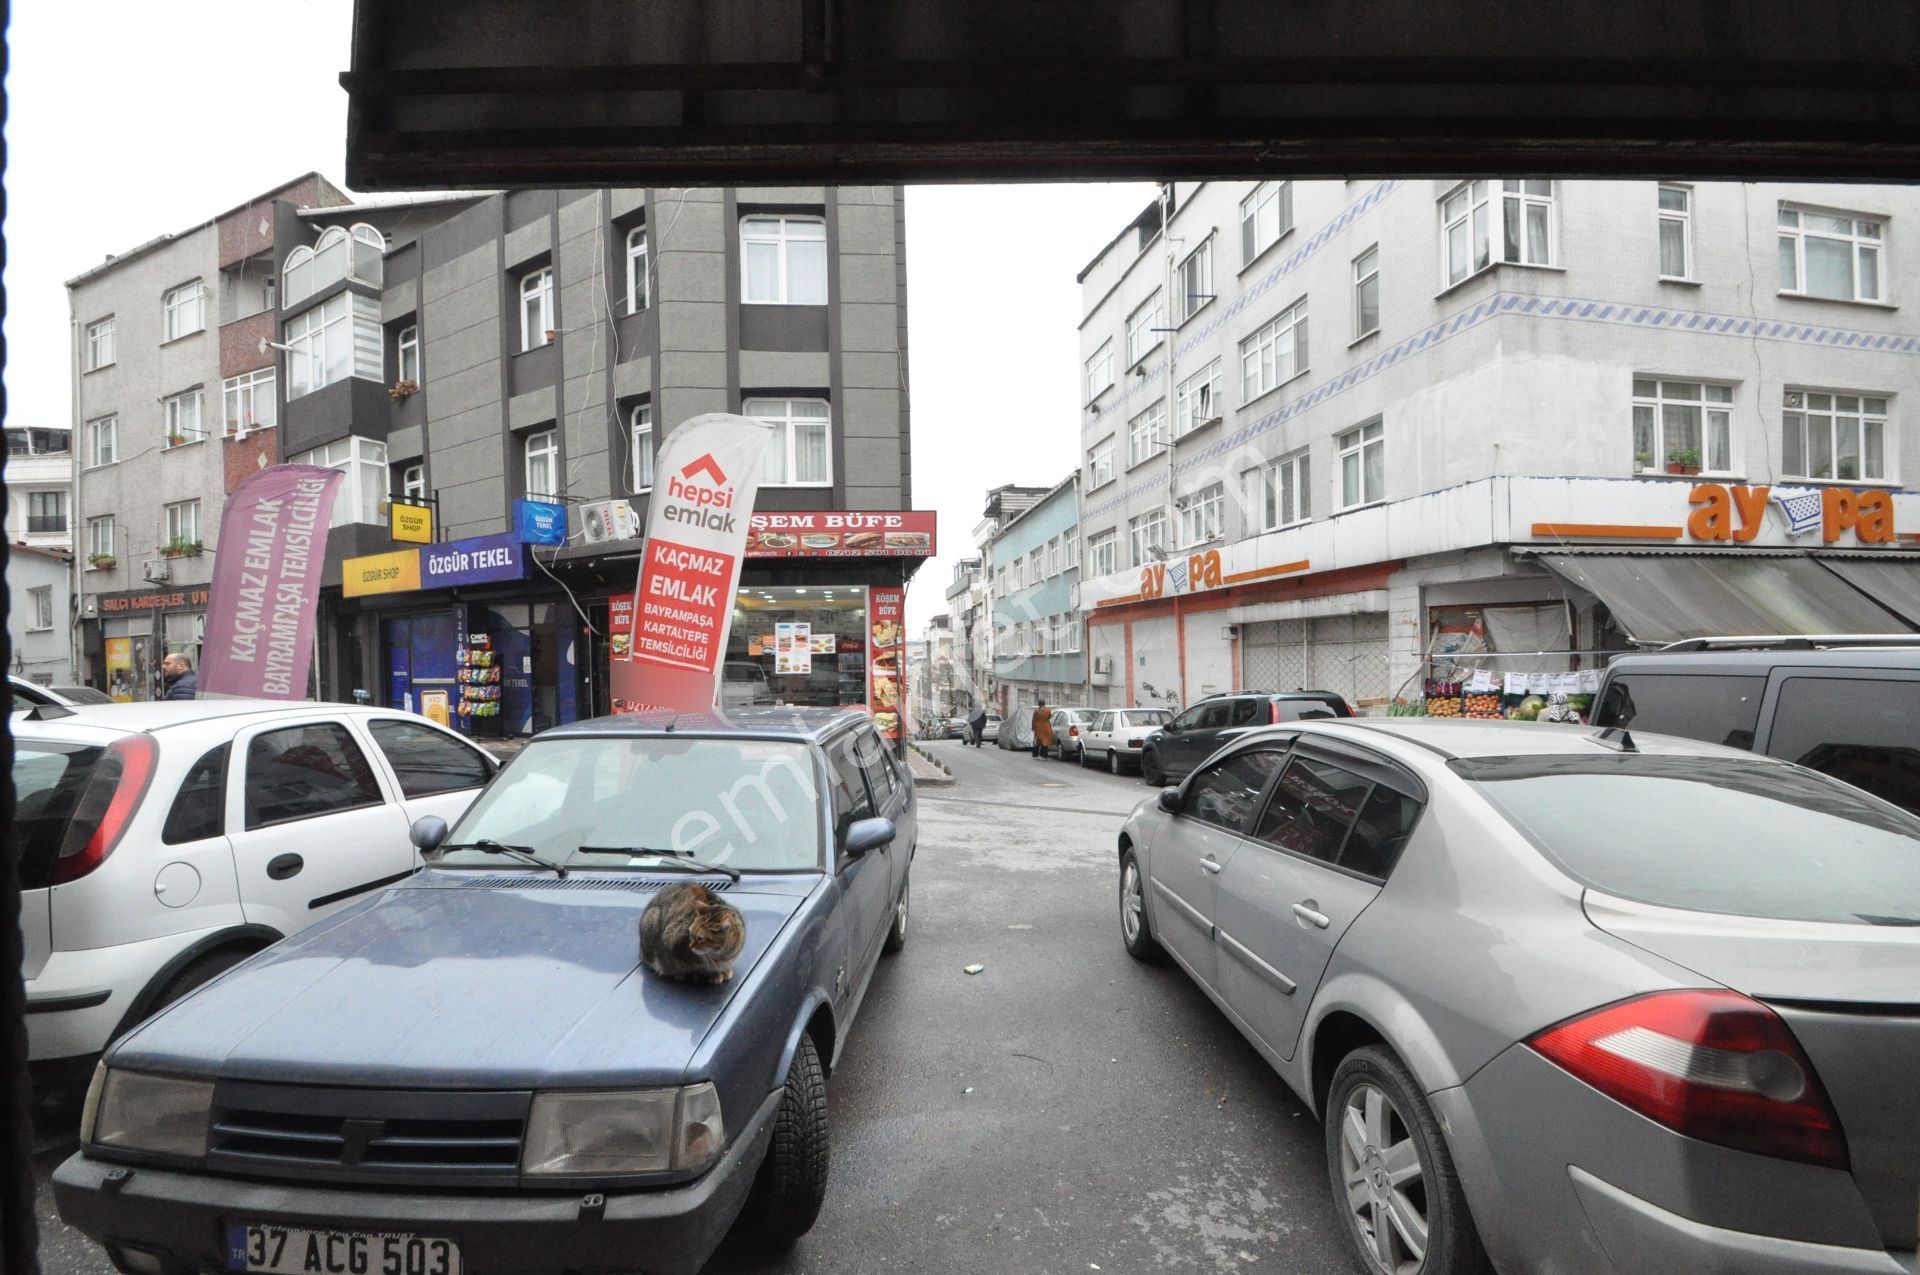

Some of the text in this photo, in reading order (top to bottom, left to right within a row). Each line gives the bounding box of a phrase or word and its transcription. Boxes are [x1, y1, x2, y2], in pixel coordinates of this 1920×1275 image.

[668, 476, 734, 510] hepsi
[400, 514, 423, 525] ÖZGÜR
[402, 523, 422, 533] SHOP
[536, 522, 553, 530] TEKEL
[603, 504, 613, 537] VESTEL
[663, 503, 737, 533] emlak
[751, 512, 903, 531] ŞEM BÜFE
[429, 547, 512, 575] ÖZGÜR TEKEL
[654, 546, 724, 577] KAÇMAZ
[229, 496, 284, 663] KAÇMAZ EMLAK
[262, 478, 328, 695] BAYRAMPAŞA TEMSİLCİLİĞİ
[362, 566, 400, 583] ÖZGÜR SHOP
[649, 575, 719, 608] EMLAK
[875, 593, 900, 604] KÖŞEM
[644, 603, 714, 628] BAYRAMPAŞA
[878, 605, 897, 615] BÜFE
[643, 620, 709, 644] KARTALTEPE
[640, 637, 708, 662] TEMSİLCİLİĞİ
[329, 1229, 351, 1239] You
[352, 1231, 373, 1239] Can
[231, 1247, 245, 1259] TR
[247, 1229, 450, 1275] 37 ACG 503
